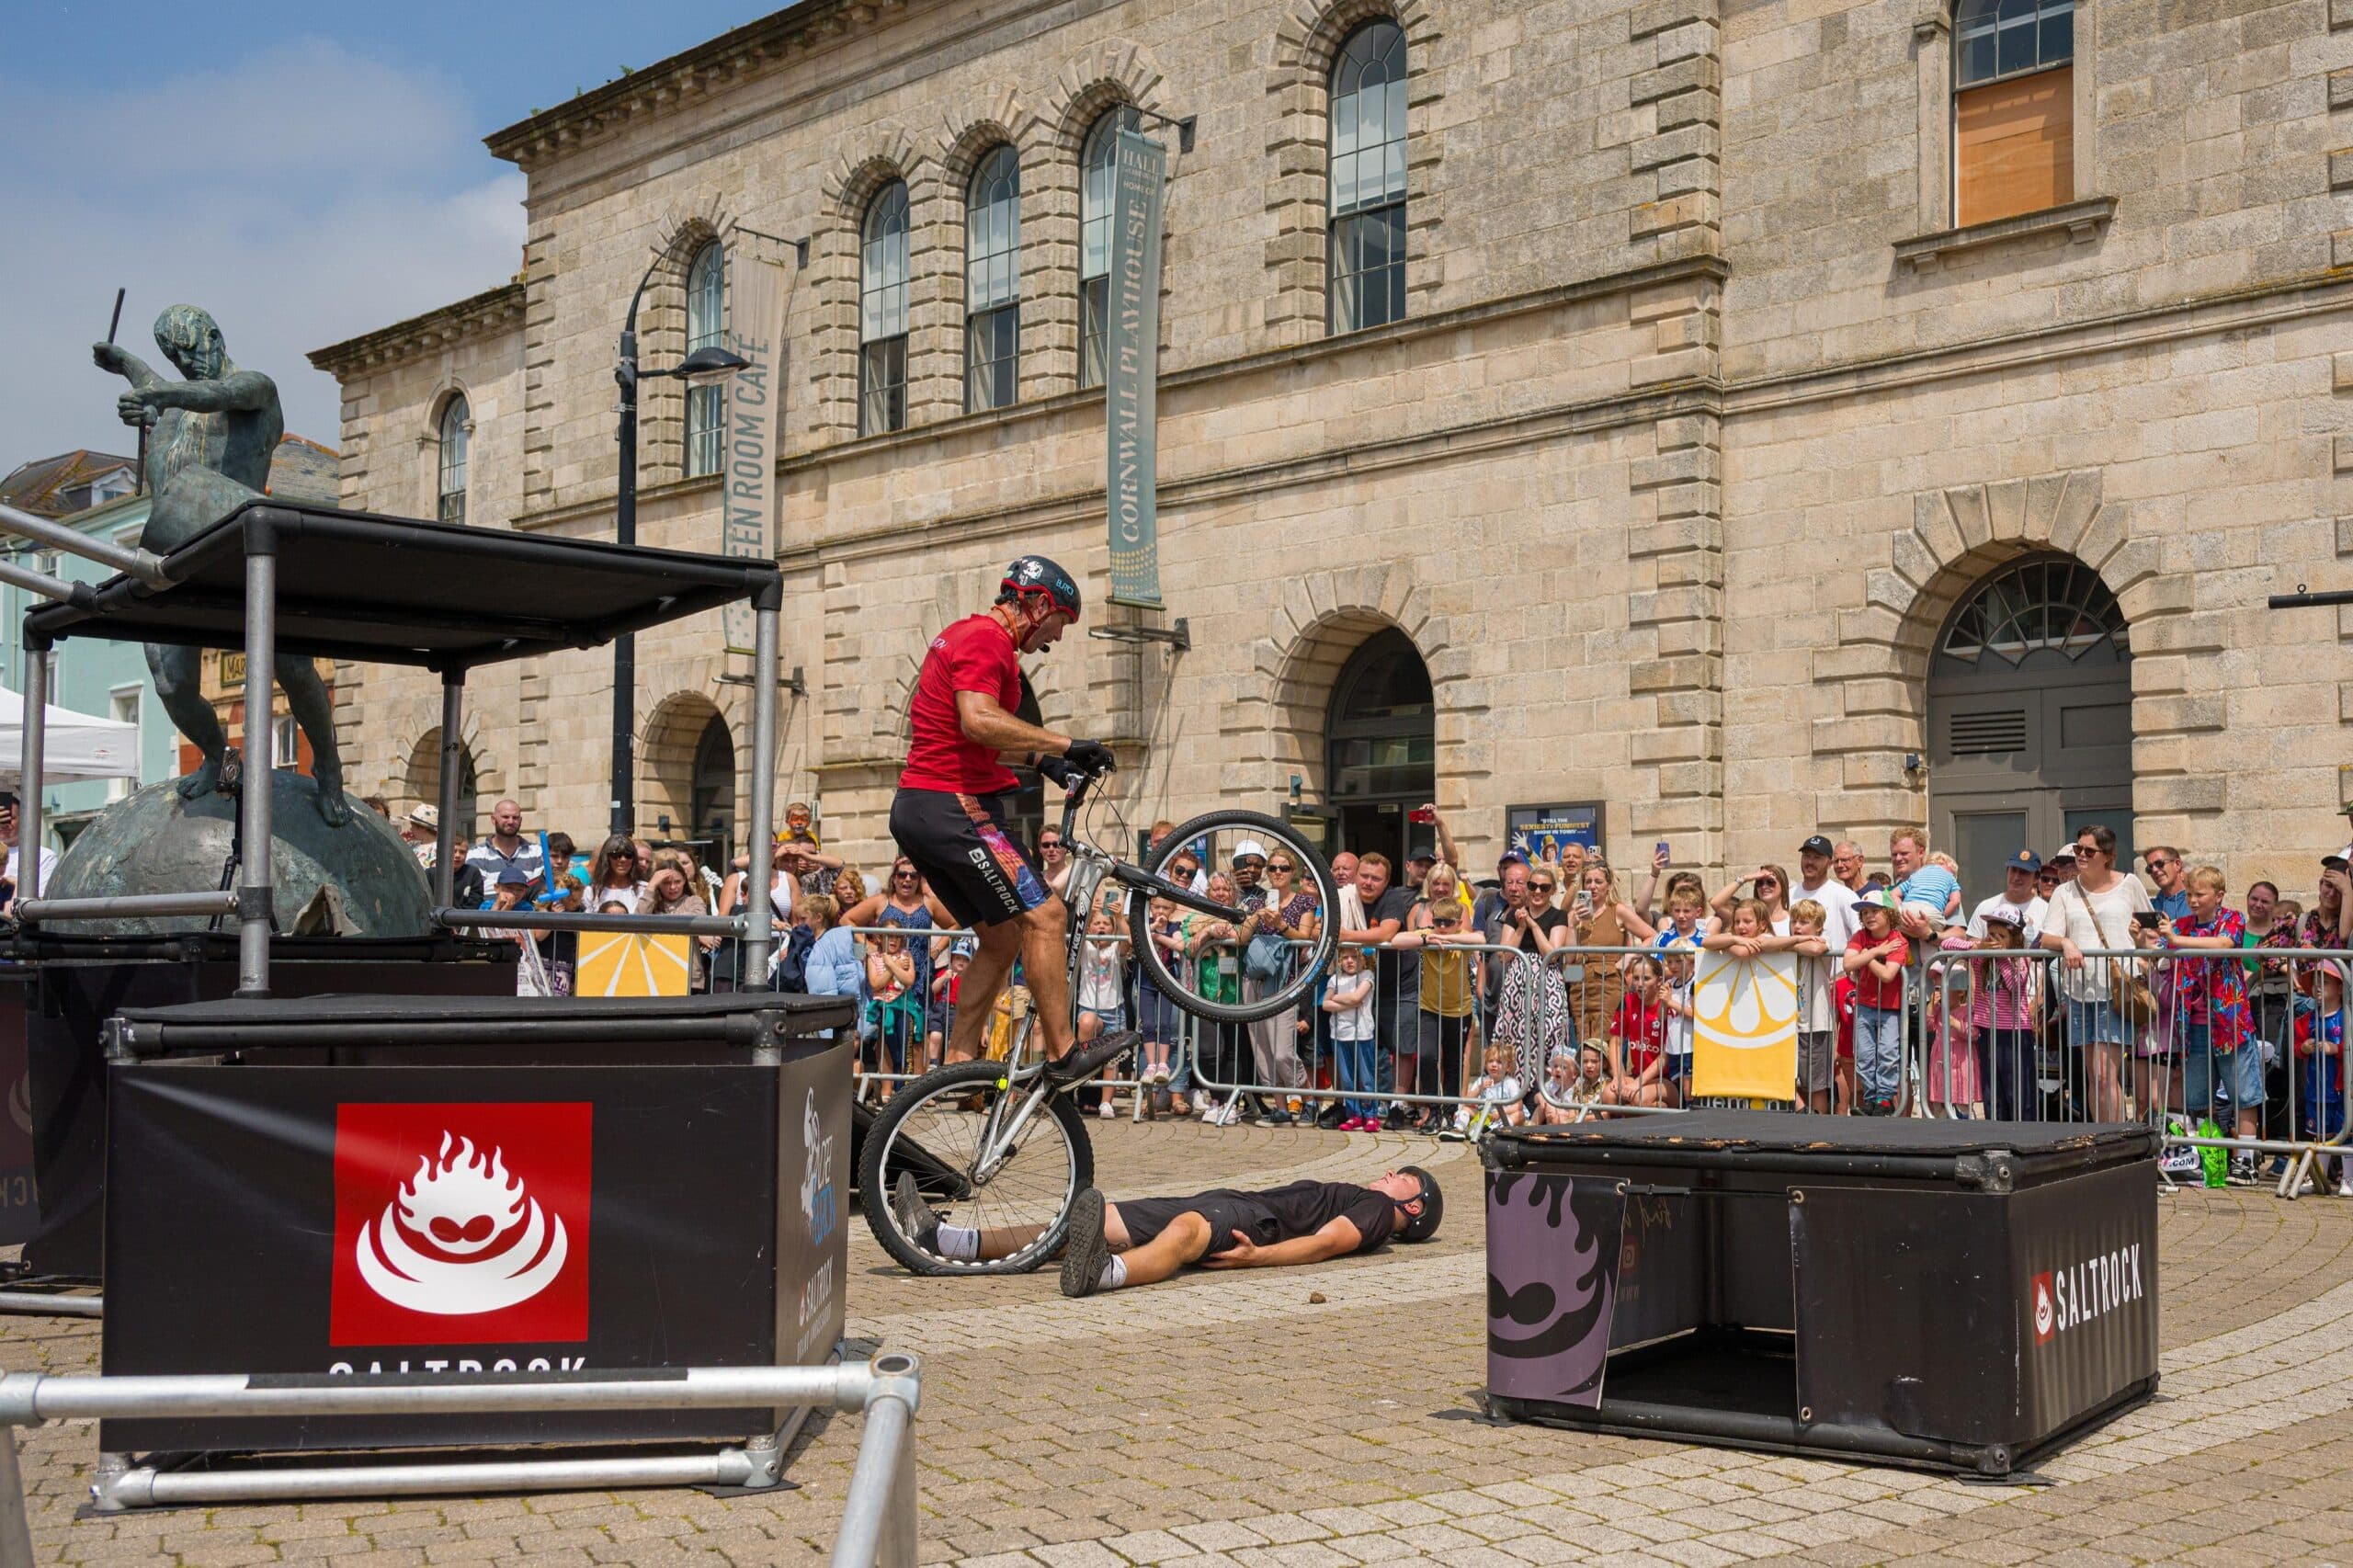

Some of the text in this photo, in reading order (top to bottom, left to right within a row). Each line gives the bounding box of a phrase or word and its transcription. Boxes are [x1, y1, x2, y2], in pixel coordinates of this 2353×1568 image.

[1120, 199, 1146, 374] PLAYHOUSE
[733, 414, 765, 500] ROOM
[1120, 382, 1139, 542] CORNWALL
[733, 507, 763, 560] EEN
[226, 656, 246, 679] MAR
[977, 860, 1020, 914] SALTROCK
[2055, 1242, 2143, 1332] SALTROCK
